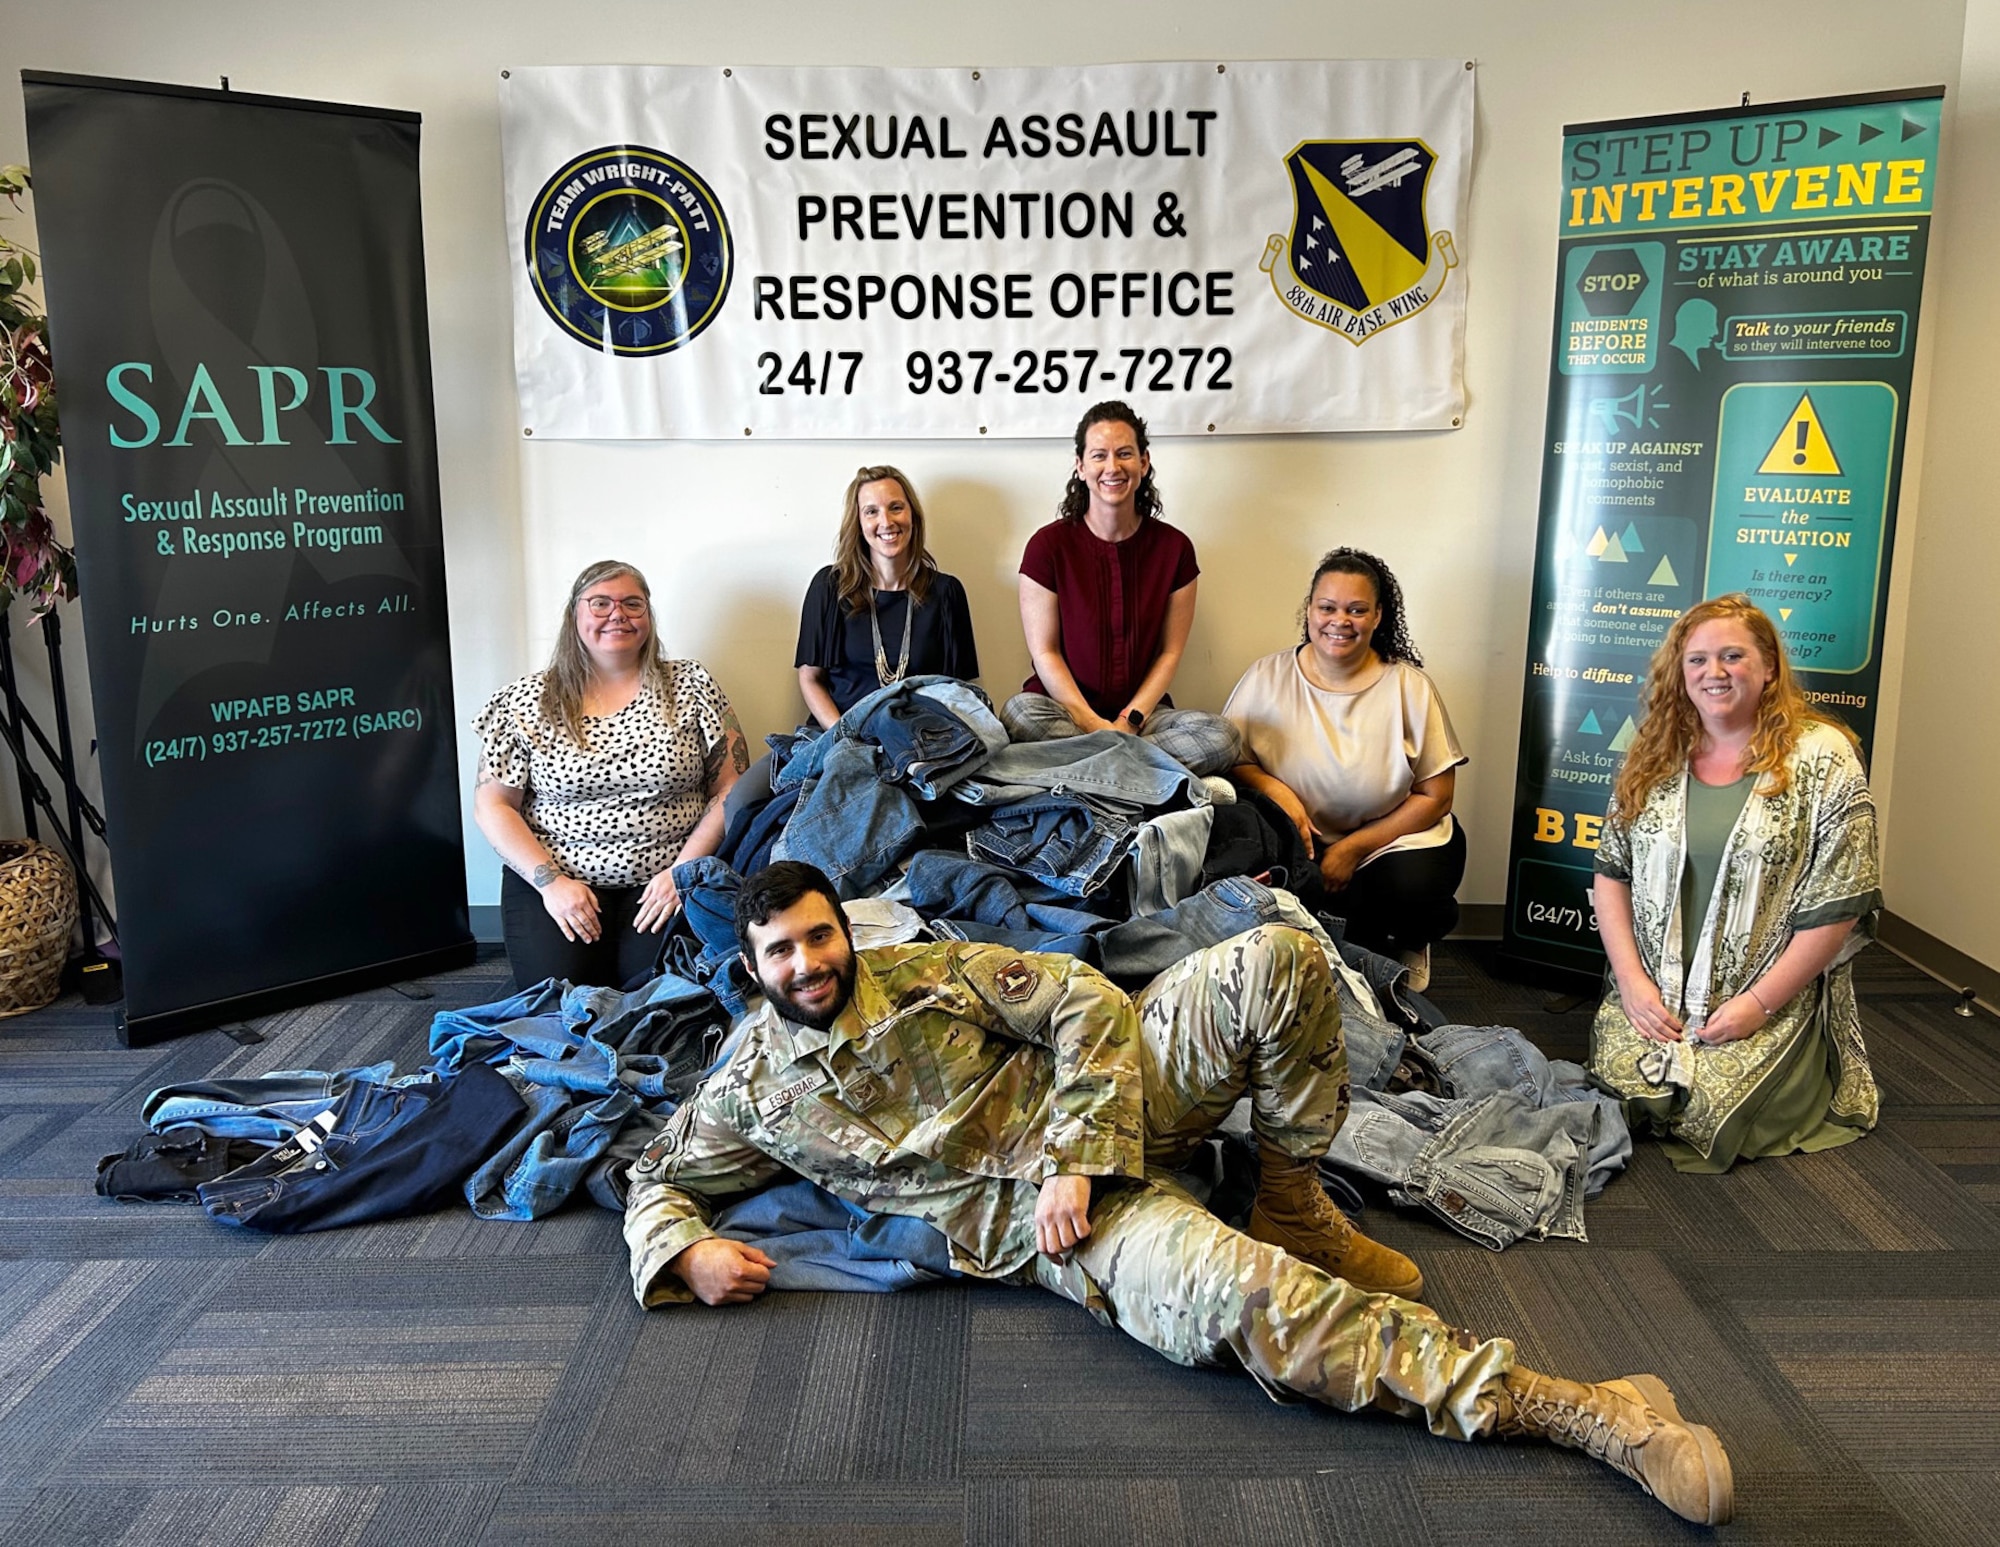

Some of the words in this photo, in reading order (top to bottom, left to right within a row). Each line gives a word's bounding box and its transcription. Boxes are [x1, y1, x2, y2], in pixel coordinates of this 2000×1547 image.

[765, 114, 967, 160] SEXUAL
[983, 110, 1217, 158] ASSAULT
[1571, 130, 1711, 181] STEP
[1729, 119, 1808, 167] UP
[546, 178, 586, 233] TEAM
[582, 163, 710, 233] WRIGHT-PATT
[1568, 159, 1926, 227] INTERVENE
[798, 192, 1132, 241] PREVENTION
[1153, 191, 1187, 238] &
[1678, 243, 1768, 272] STAY
[1771, 235, 1910, 267] AWARE
[1584, 274, 1641, 293] STOP
[1697, 272, 1716, 288] of
[1717, 271, 1761, 287] what
[1764, 271, 1779, 285] is
[1782, 266, 1844, 284] around
[1849, 267, 1883, 284] you
[754, 273, 1033, 320] RESPONSE
[1050, 271, 1234, 318] OFFICE
[1286, 285, 1315, 315] 88th
[1316, 303, 1344, 327] AIR
[1344, 308, 1386, 336] BASE
[1387, 286, 1429, 318] WING
[1570, 319, 1648, 333] INCIDENTS
[1735, 321, 1770, 337] Talk
[1773, 322, 1789, 335] to
[1792, 321, 1831, 338] your
[1832, 318, 1896, 337] friends
[1568, 334, 1647, 351] BEFORE
[1733, 342, 1747, 351] so
[1750, 339, 1777, 354] they
[1780, 338, 1803, 351] will
[1806, 338, 1867, 350] intervene
[1869, 338, 1891, 349] too
[1567, 354, 1599, 366] THEY
[1601, 353, 1646, 364] OCCUR
[758, 351, 864, 395] 24/7
[906, 347, 1233, 395] 937-257-7272
[106, 362, 402, 449] SAPR
[1605, 442, 1627, 454] UP
[1630, 442, 1703, 455] AGAINST
[1609, 460, 1653, 474] sexist,
[1656, 460, 1683, 473] and
[121, 489, 202, 522] Sexual
[210, 487, 287, 519] Assault
[294, 487, 404, 515] Prevention
[1587, 495, 1655, 507] comments
[1744, 487, 1851, 505] EVALUATE
[1781, 509, 1809, 525] the
[157, 530, 176, 555] &
[183, 526, 286, 558] Response
[293, 522, 383, 552] Program
[1736, 528, 1851, 548] SITUATION
[1752, 569, 1765, 581] Is
[1768, 570, 1805, 584] there
[1808, 574, 1827, 585] an
[1594, 586, 1603, 597] if
[1605, 588, 1643, 601] others
[1645, 592, 1665, 602] are
[1745, 587, 1832, 603] emergency?
[131, 616, 198, 634] Hurts
[213, 610, 270, 627] One.
[285, 601, 365, 621] Affects
[378, 595, 416, 614] All.
[1592, 602, 1628, 615] don't
[1629, 608, 1681, 619] assume
[1584, 618, 1636, 631] someone
[1639, 621, 1664, 633] else
[1599, 633, 1611, 644] to
[1613, 634, 1662, 648] interven
[1779, 630, 1836, 642] omeone
[1532, 663, 1562, 678] Help
[1565, 667, 1578, 678] to
[1582, 668, 1634, 684] diffuse
[211, 694, 291, 723] WPAFB
[297, 687, 356, 712] SAPR
[145, 735, 206, 767] (24/7)
[212, 717, 347, 753] 937-257-7272
[353, 707, 423, 739] (SARC)
[1562, 749, 1590, 765] Ask
[1594, 753, 1614, 768] for
[1551, 768, 1612, 785] support
[1527, 901, 1582, 931] (24/7)
[769, 1076, 817, 1109] ESCOBAR
